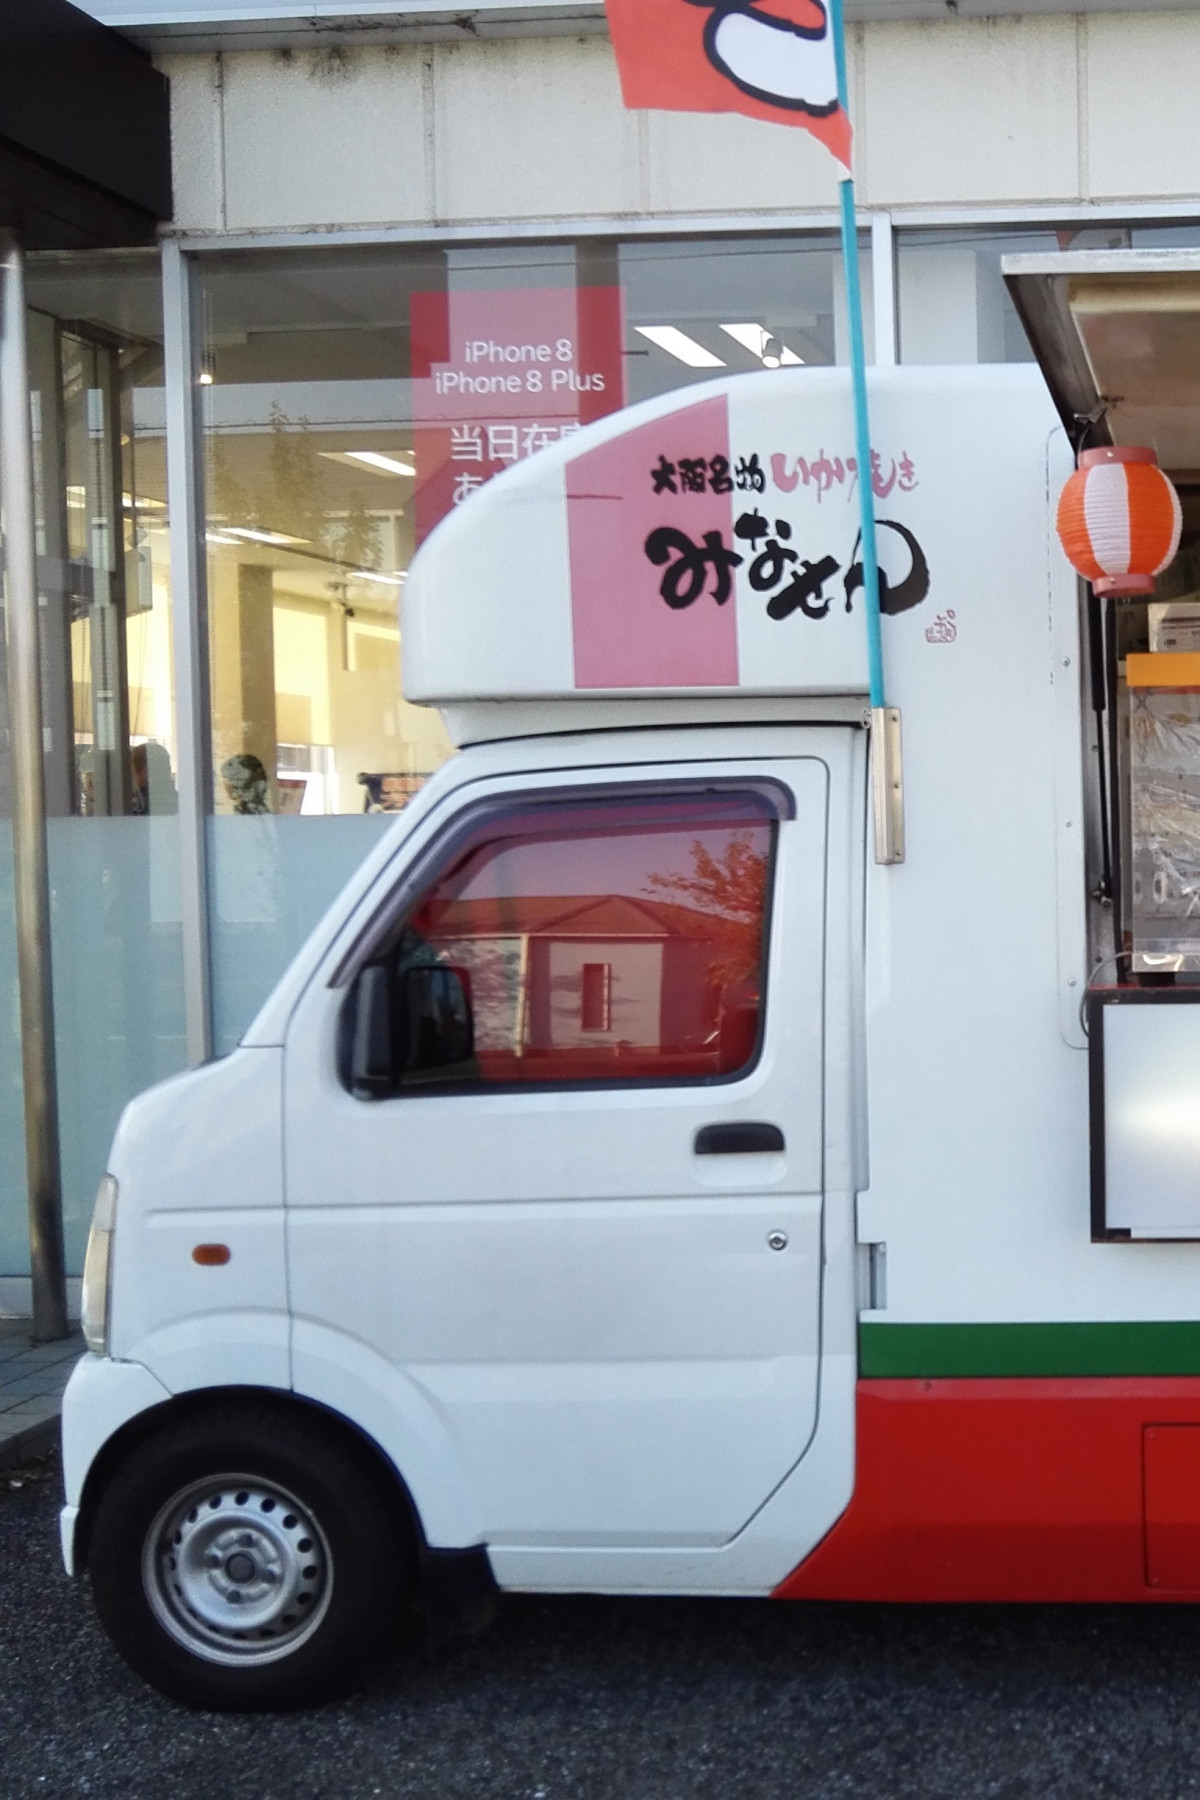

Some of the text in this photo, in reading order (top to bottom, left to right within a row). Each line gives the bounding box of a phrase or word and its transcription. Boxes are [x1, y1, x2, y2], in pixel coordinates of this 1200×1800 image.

[465, 338, 573, 363] iPhone 8
[435, 368, 605, 394] iPhone 8 Plus
[451, 422, 583, 461] 当日在
